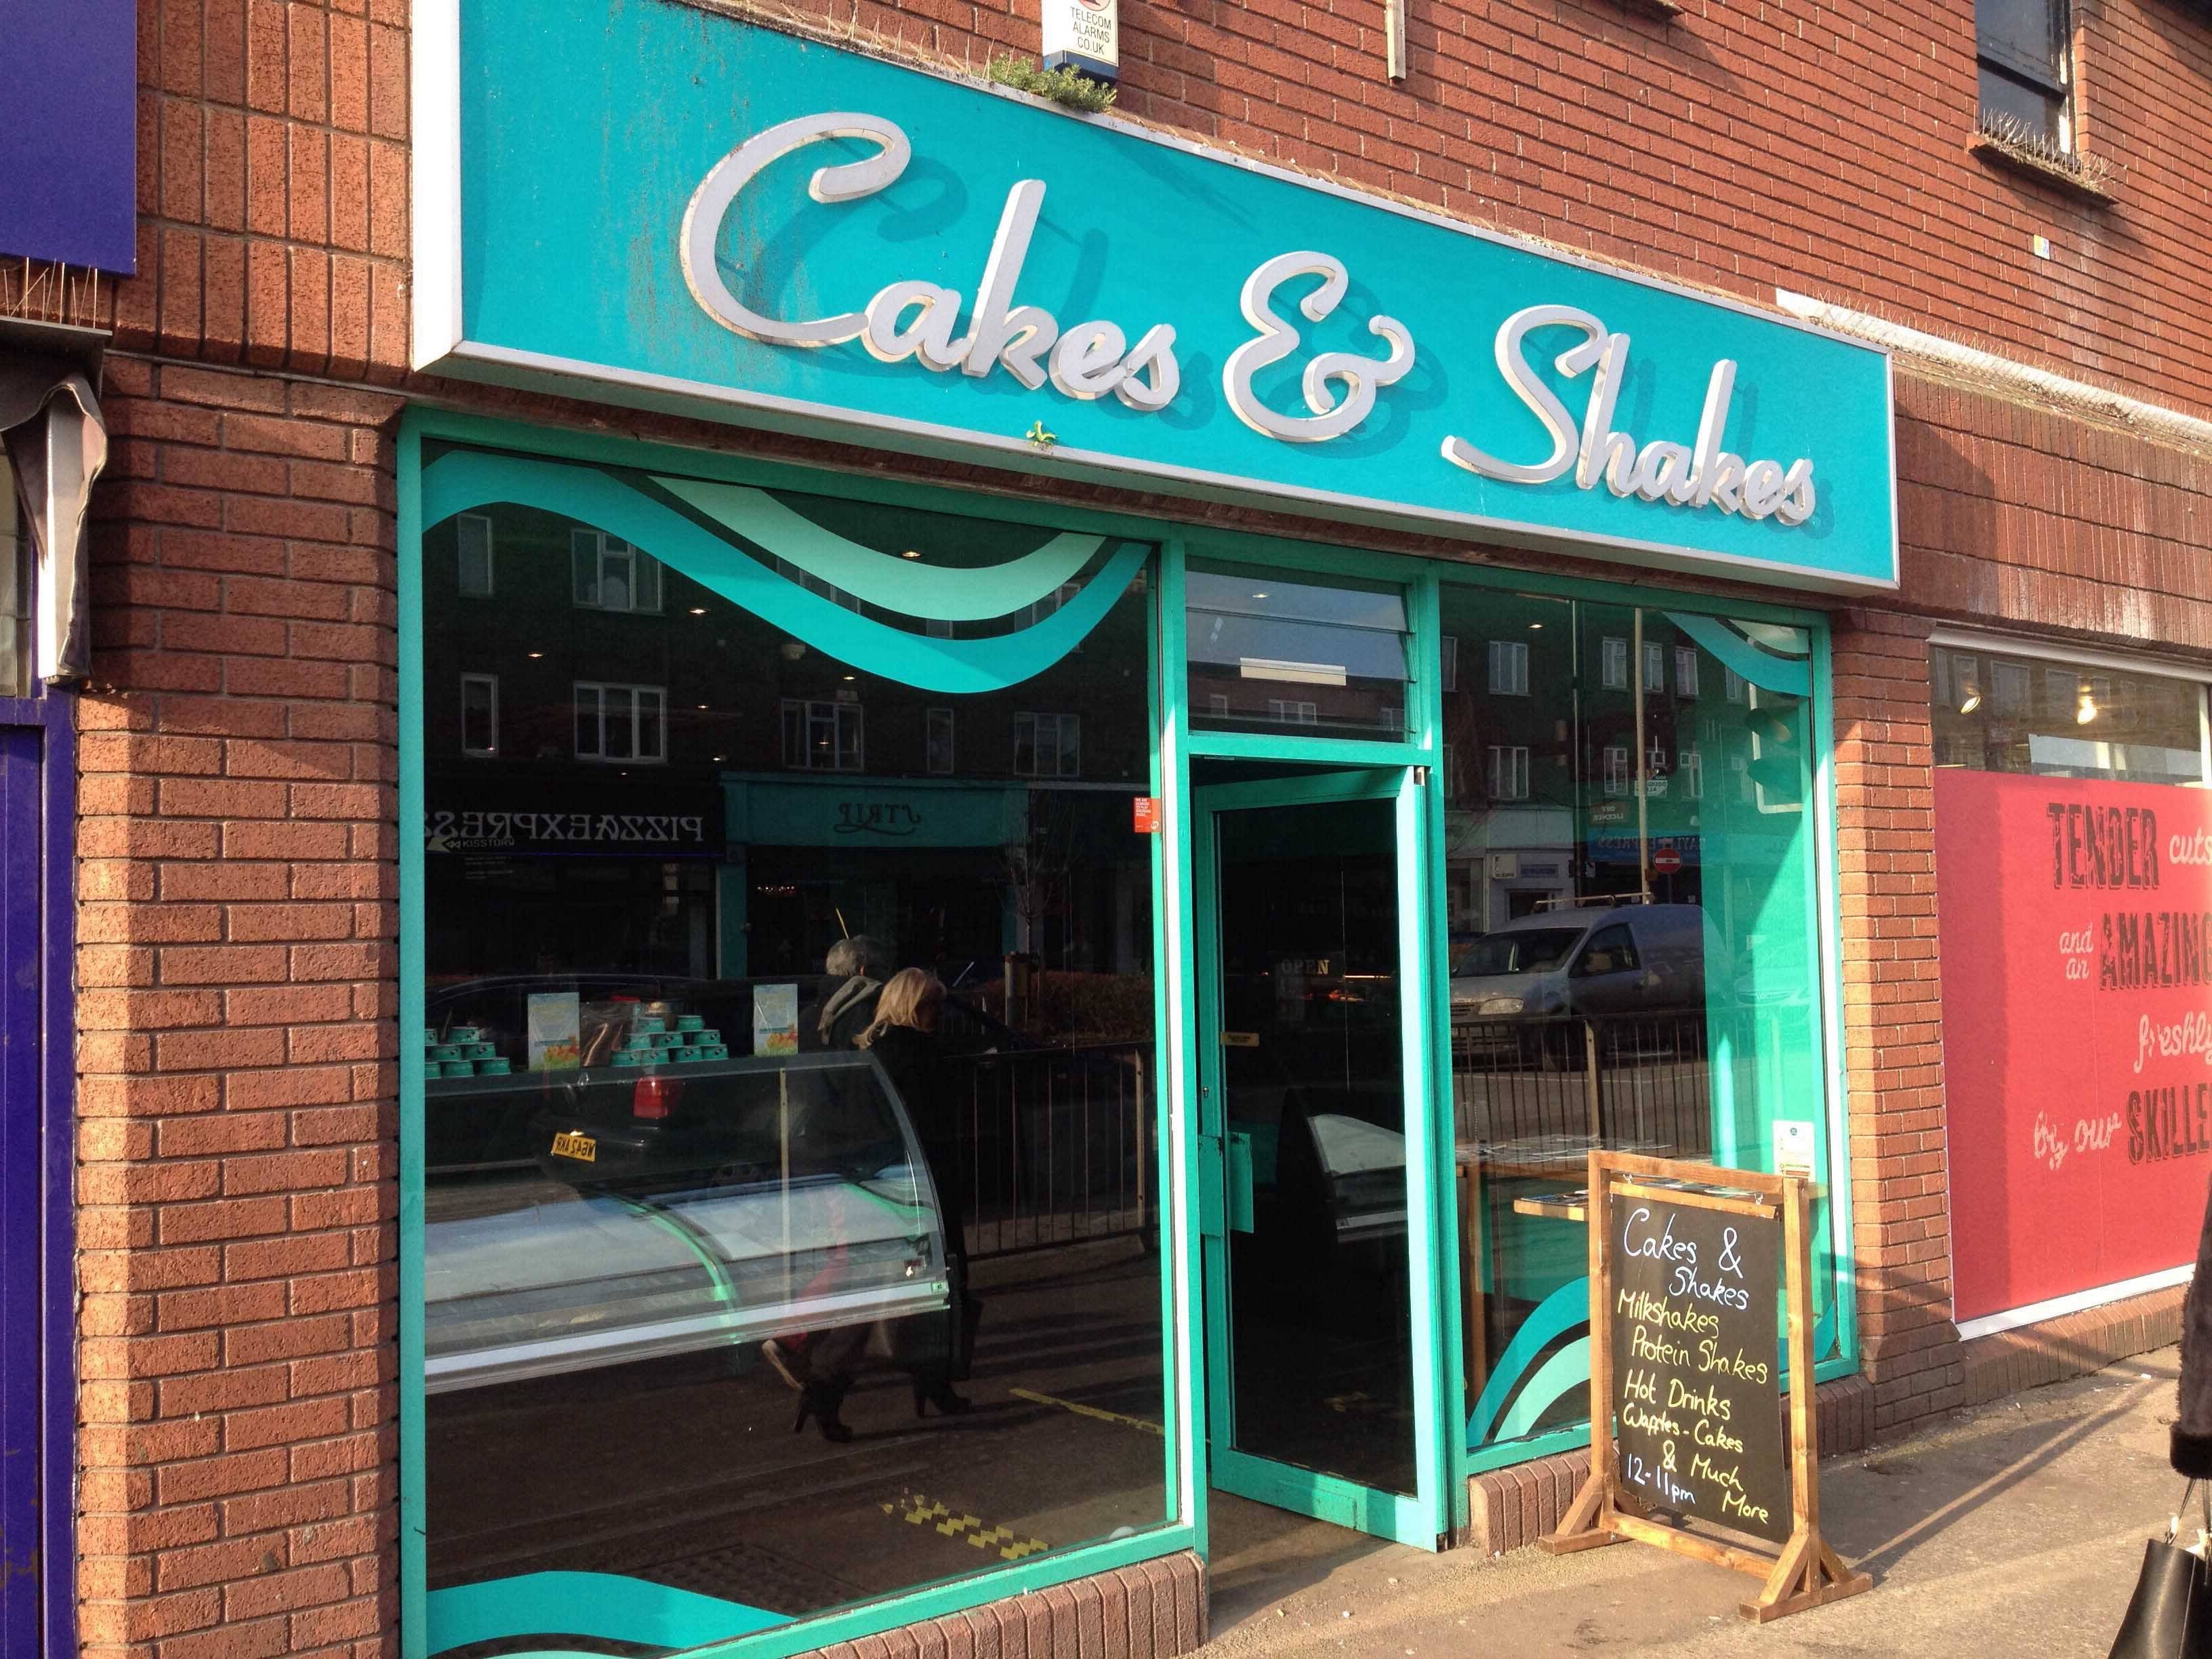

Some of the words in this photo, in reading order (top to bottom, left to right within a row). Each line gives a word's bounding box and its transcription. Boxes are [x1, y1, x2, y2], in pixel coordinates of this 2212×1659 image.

[1070, 6, 1111, 30] TELECOM
[1073, 21, 1110, 43] ALARMS
[1078, 37, 1105, 55] CO.UK
[680, 112, 1180, 411] Cakes
[1223, 250, 1415, 442] &
[1440, 304, 1816, 527] Shakes
[2047, 802, 2160, 890] TENDER
[2059, 922, 2094, 954] and
[2066, 958, 2089, 980] an
[2033, 1110, 2070, 1171] by
[2074, 1112, 2122, 1153] our
[2127, 1082, 2212, 1166] SKILLE
[1624, 1208, 1697, 1264] Cakes
[1718, 1227, 1744, 1279] &
[1668, 1266, 1750, 1310] Shakes
[1618, 1288, 1719, 1339] Milkshakes
[1631, 1325, 1690, 1367] Protein
[1698, 1339, 1768, 1385] Shakes
[1624, 1368, 1656, 1404] Hot
[1668, 1378, 1731, 1420] Drinks
[1694, 1418, 1743, 1453] Cakes
[1662, 1439, 1677, 1473] &
[1690, 1453, 1744, 1491] Much
[1721, 1490, 1769, 1524] More
